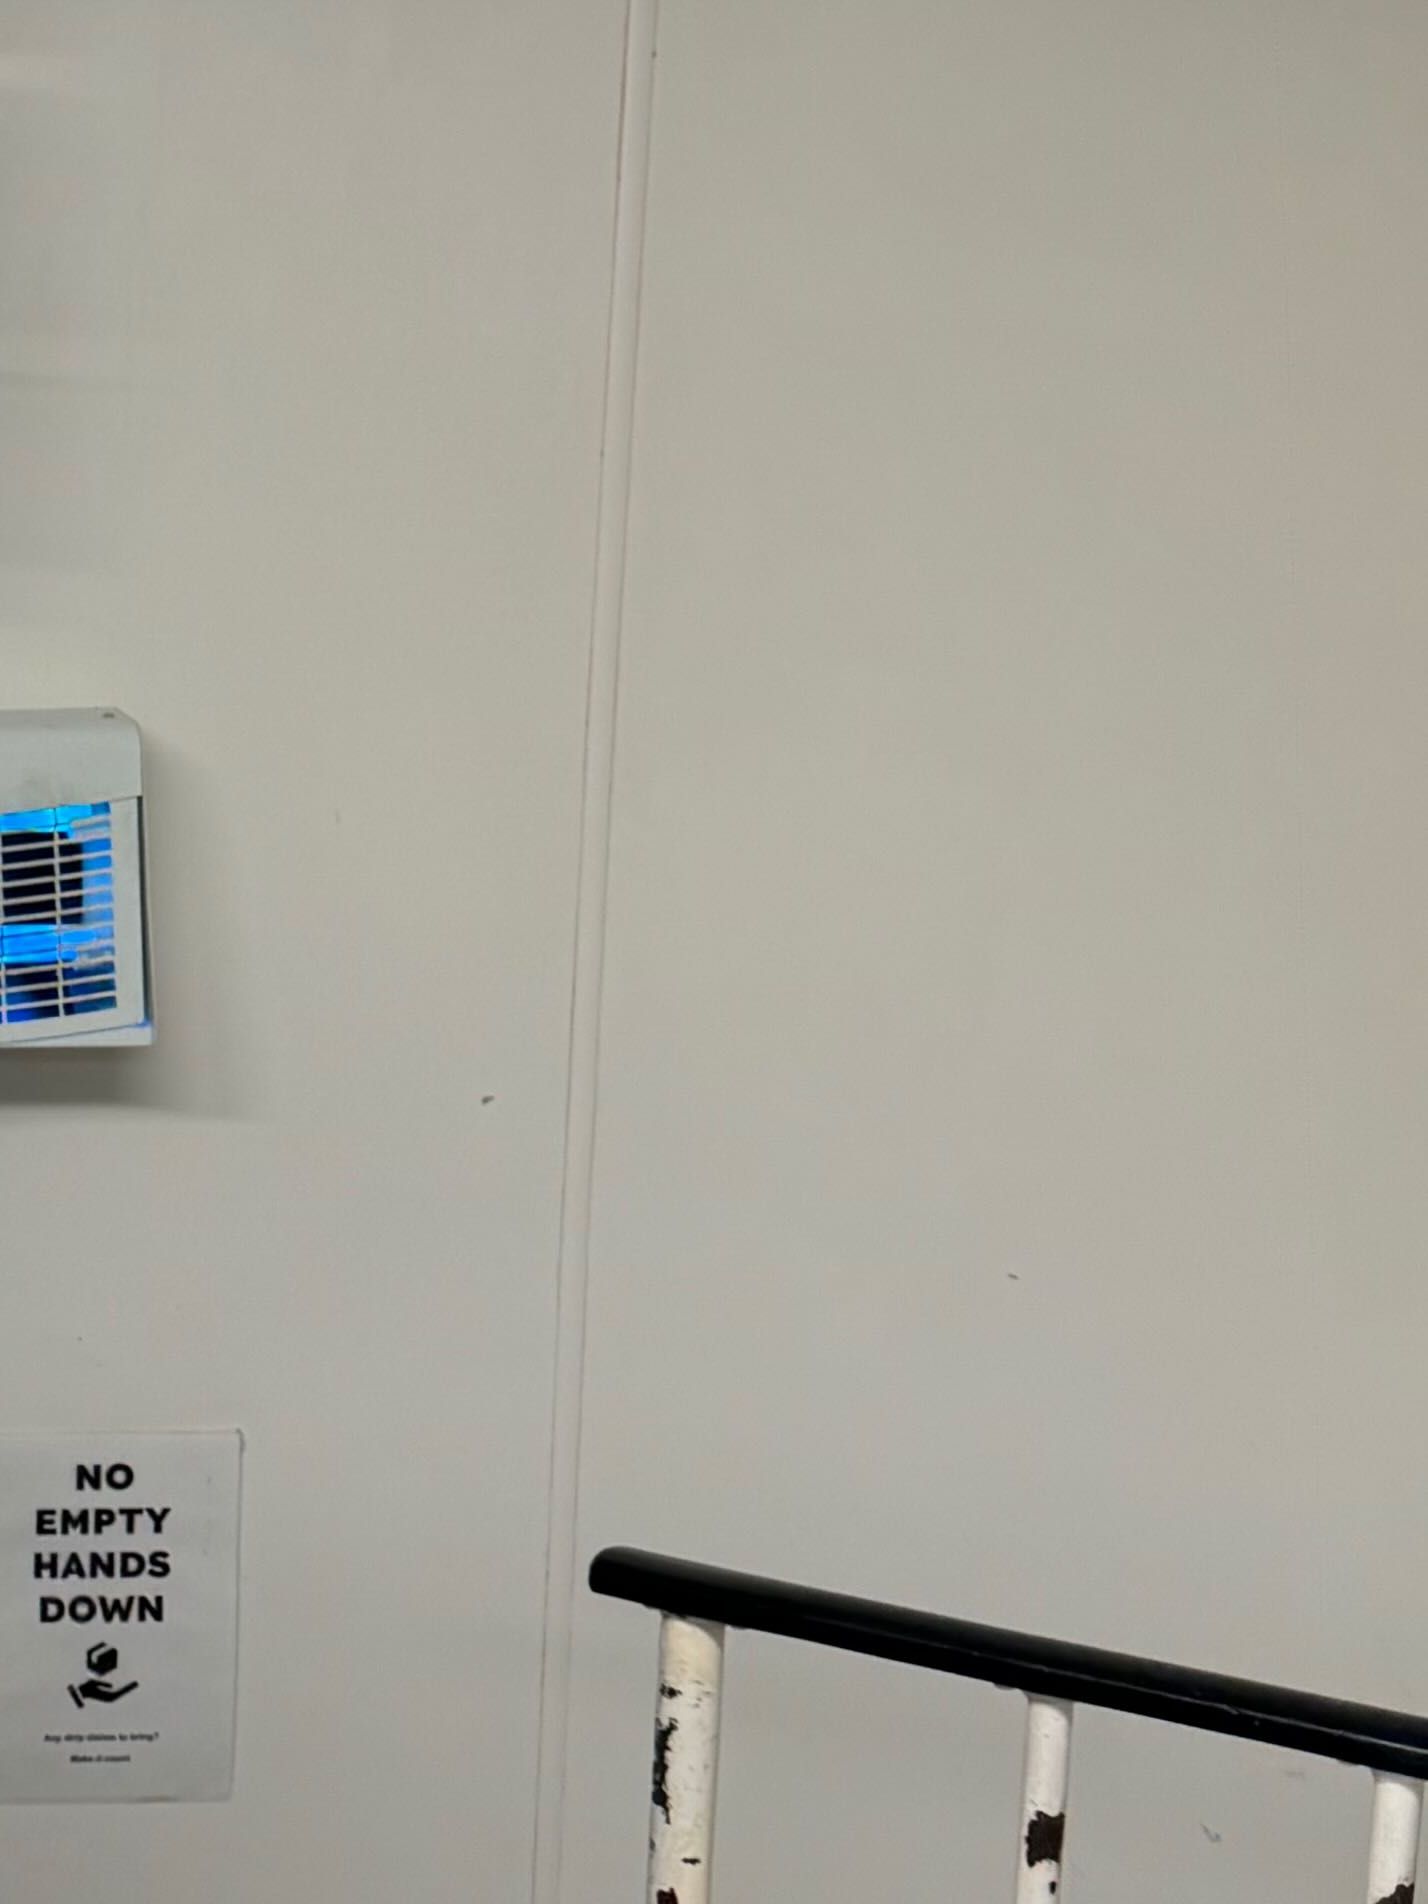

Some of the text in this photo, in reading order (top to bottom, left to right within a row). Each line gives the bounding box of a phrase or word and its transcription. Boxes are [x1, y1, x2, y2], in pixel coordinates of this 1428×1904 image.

[76, 1463, 134, 1491] NO
[35, 1507, 172, 1536] EMPTY
[33, 1551, 171, 1580] HANDS
[39, 1595, 164, 1624] DOWN
